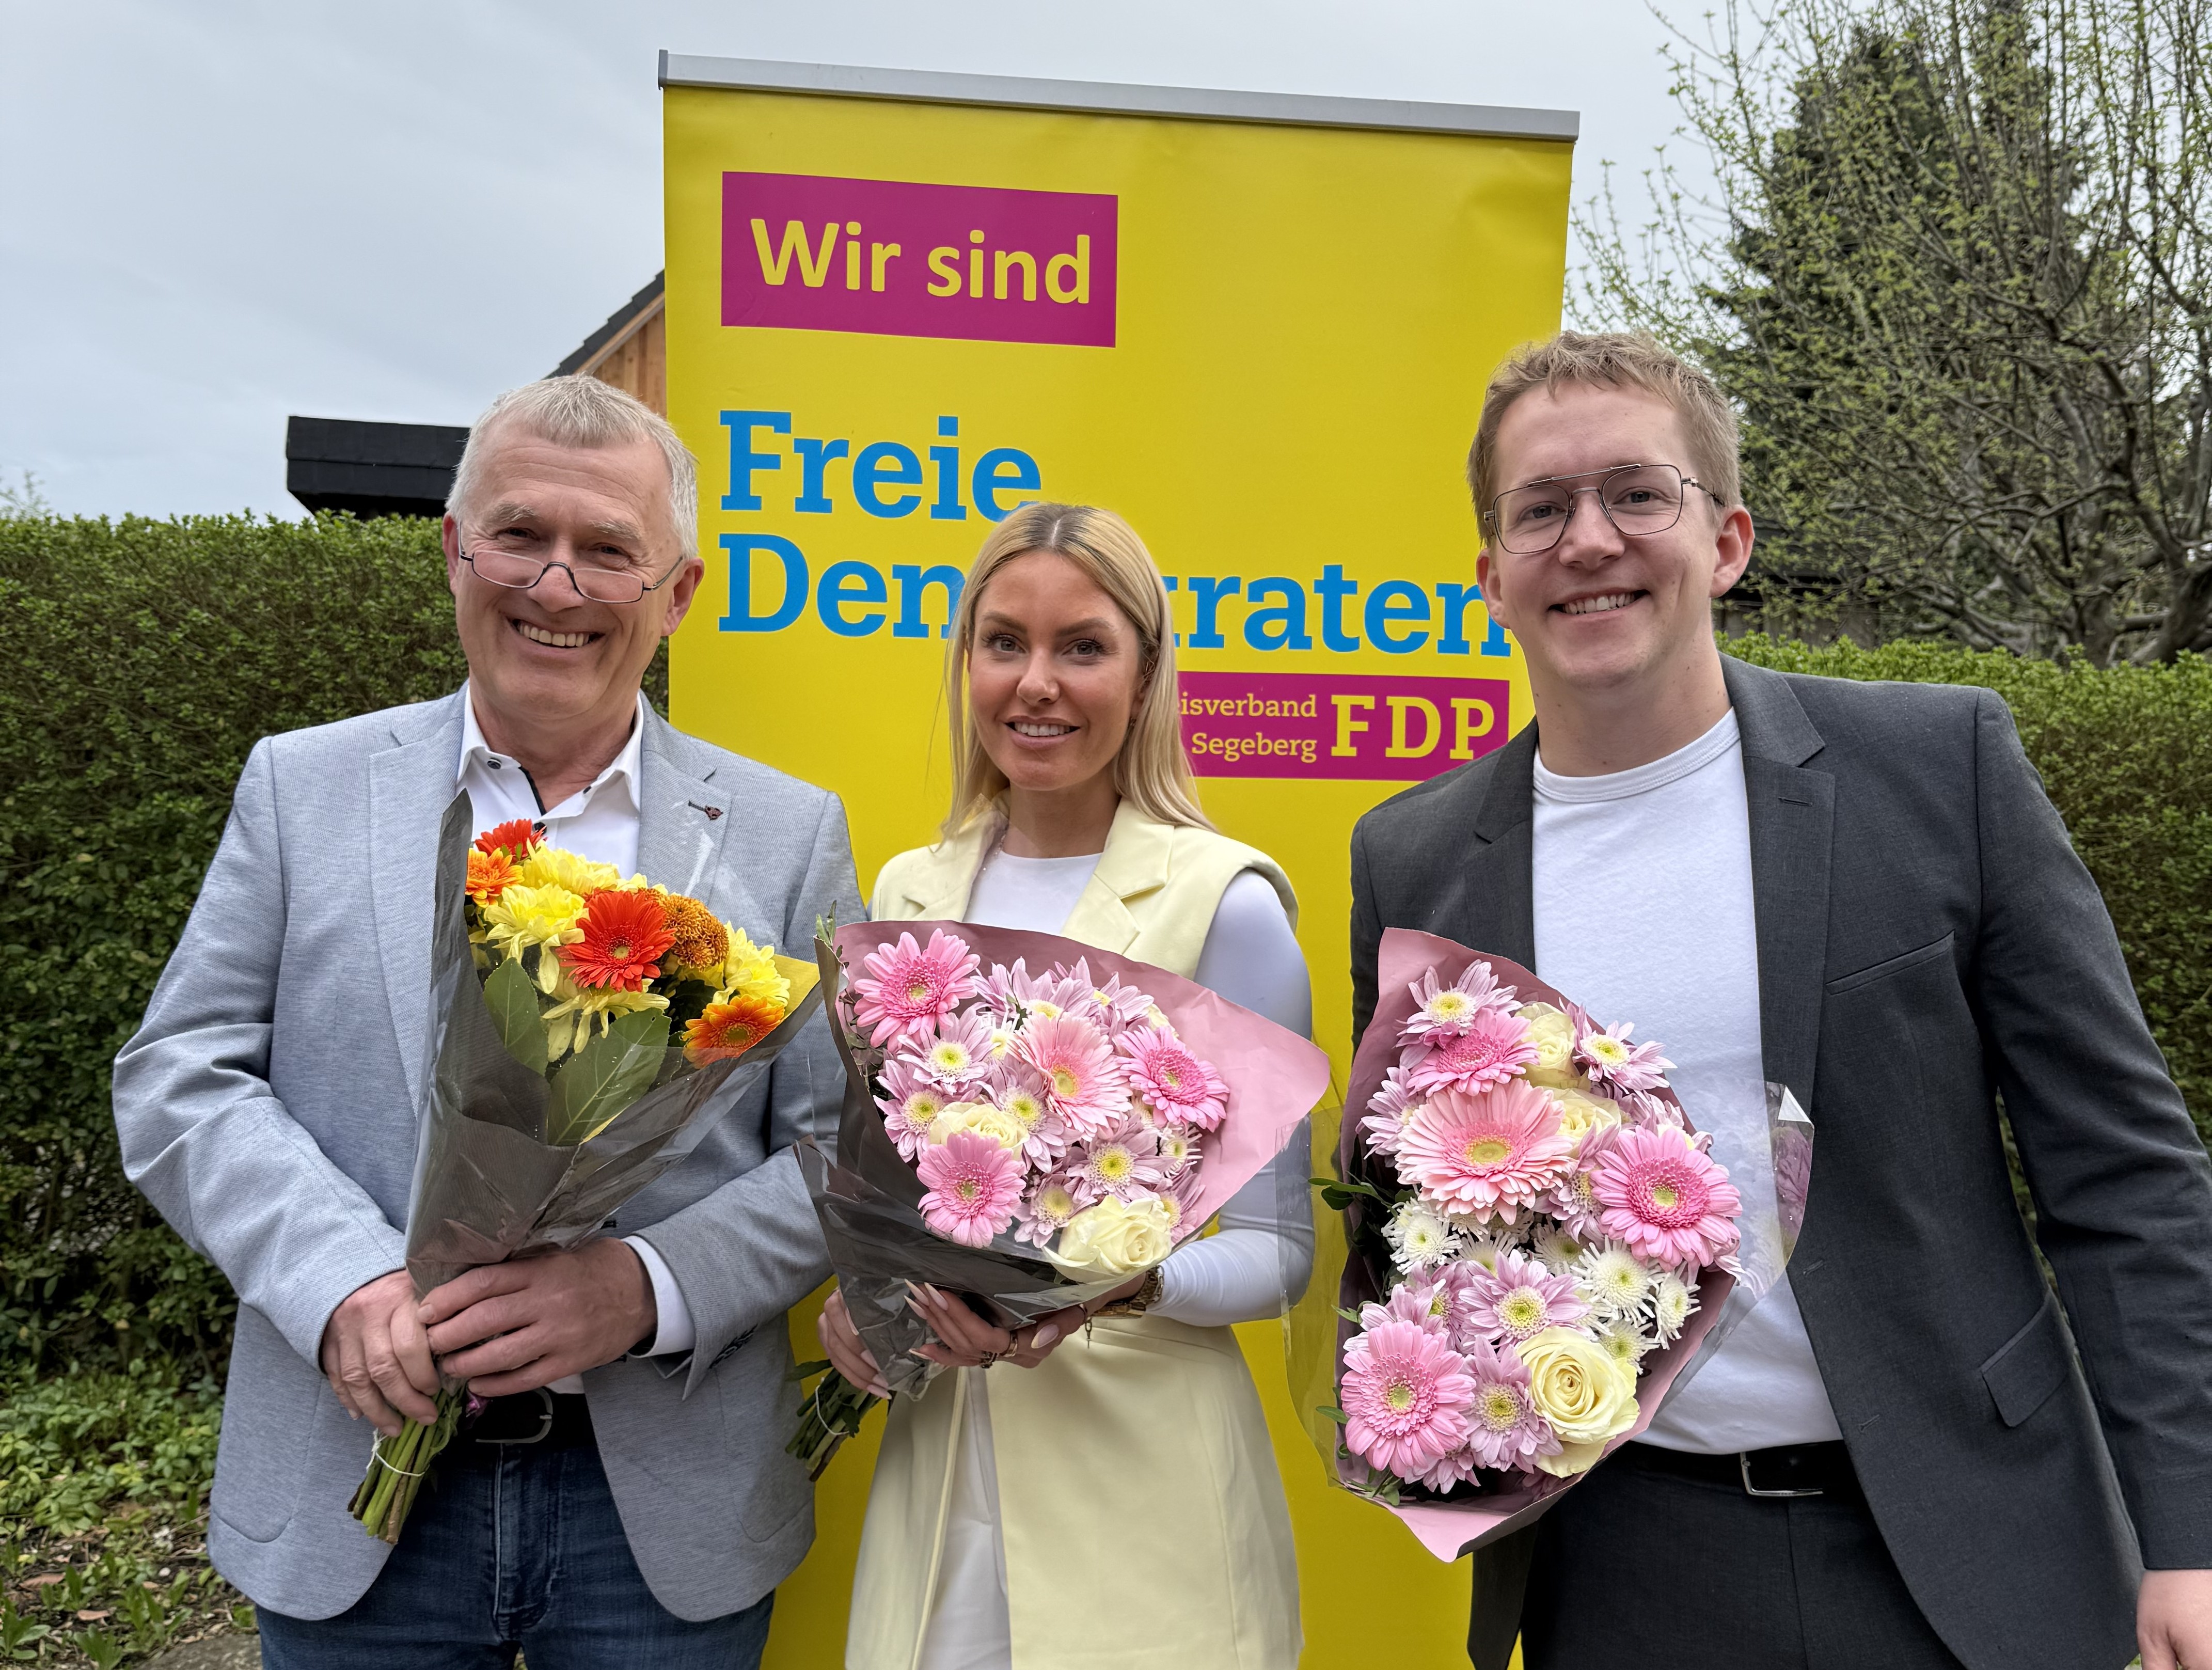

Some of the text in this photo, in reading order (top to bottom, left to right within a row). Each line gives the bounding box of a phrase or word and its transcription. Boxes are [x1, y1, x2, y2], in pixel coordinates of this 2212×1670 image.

[750, 218, 1090, 304] Wir sind
[720, 410, 1041, 522] Freie
[718, 533, 1511, 657] Demraten
[1177, 691, 1317, 717] isverband
[1331, 695, 1494, 761] FDP
[1191, 732, 1317, 763] Segeberg
